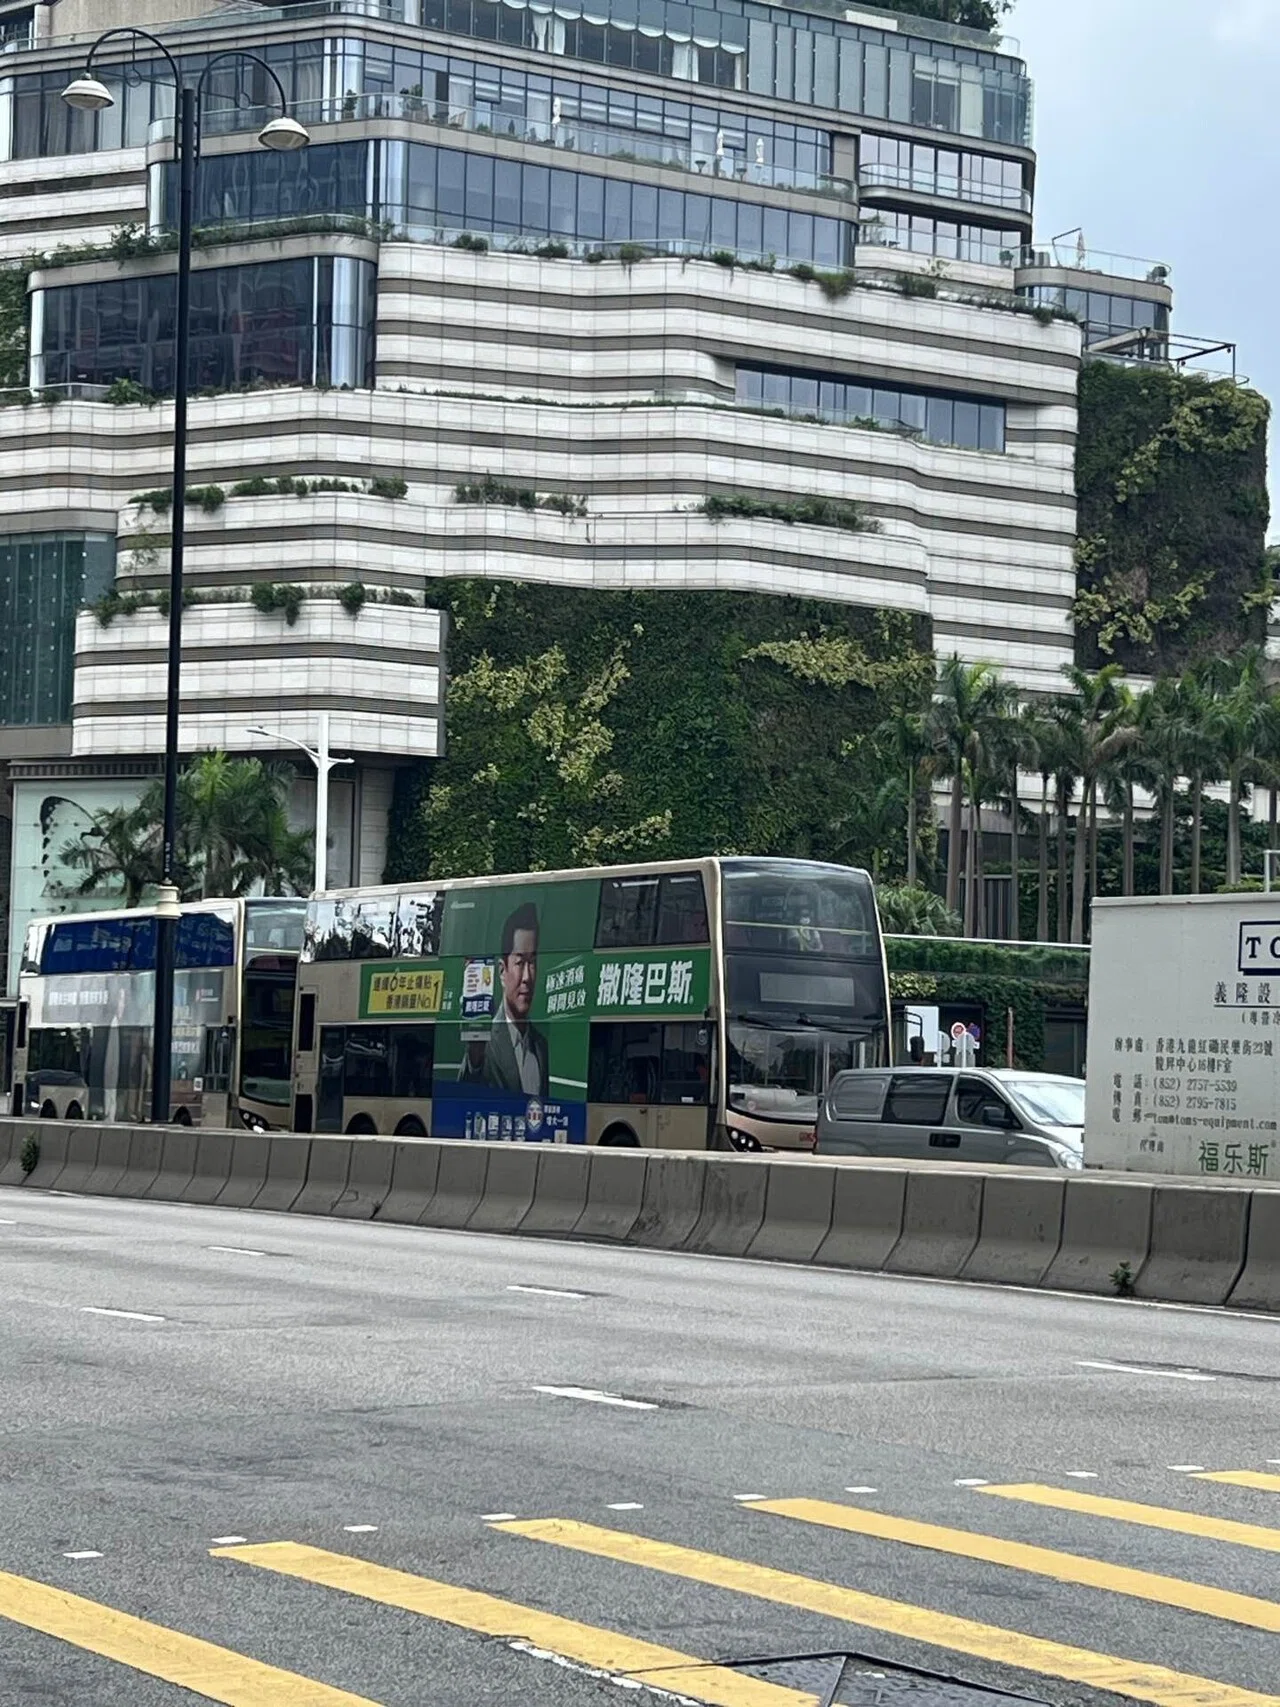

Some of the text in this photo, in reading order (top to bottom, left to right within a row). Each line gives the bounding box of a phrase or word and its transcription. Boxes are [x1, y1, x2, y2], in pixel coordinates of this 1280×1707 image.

[597, 960, 693, 1005] 撒隆巴斯
[1153, 1076, 1181, 1092] (852)
[1153, 1094, 1180, 1110] (852)
[1198, 1141, 1269, 1176] 福乐斯
